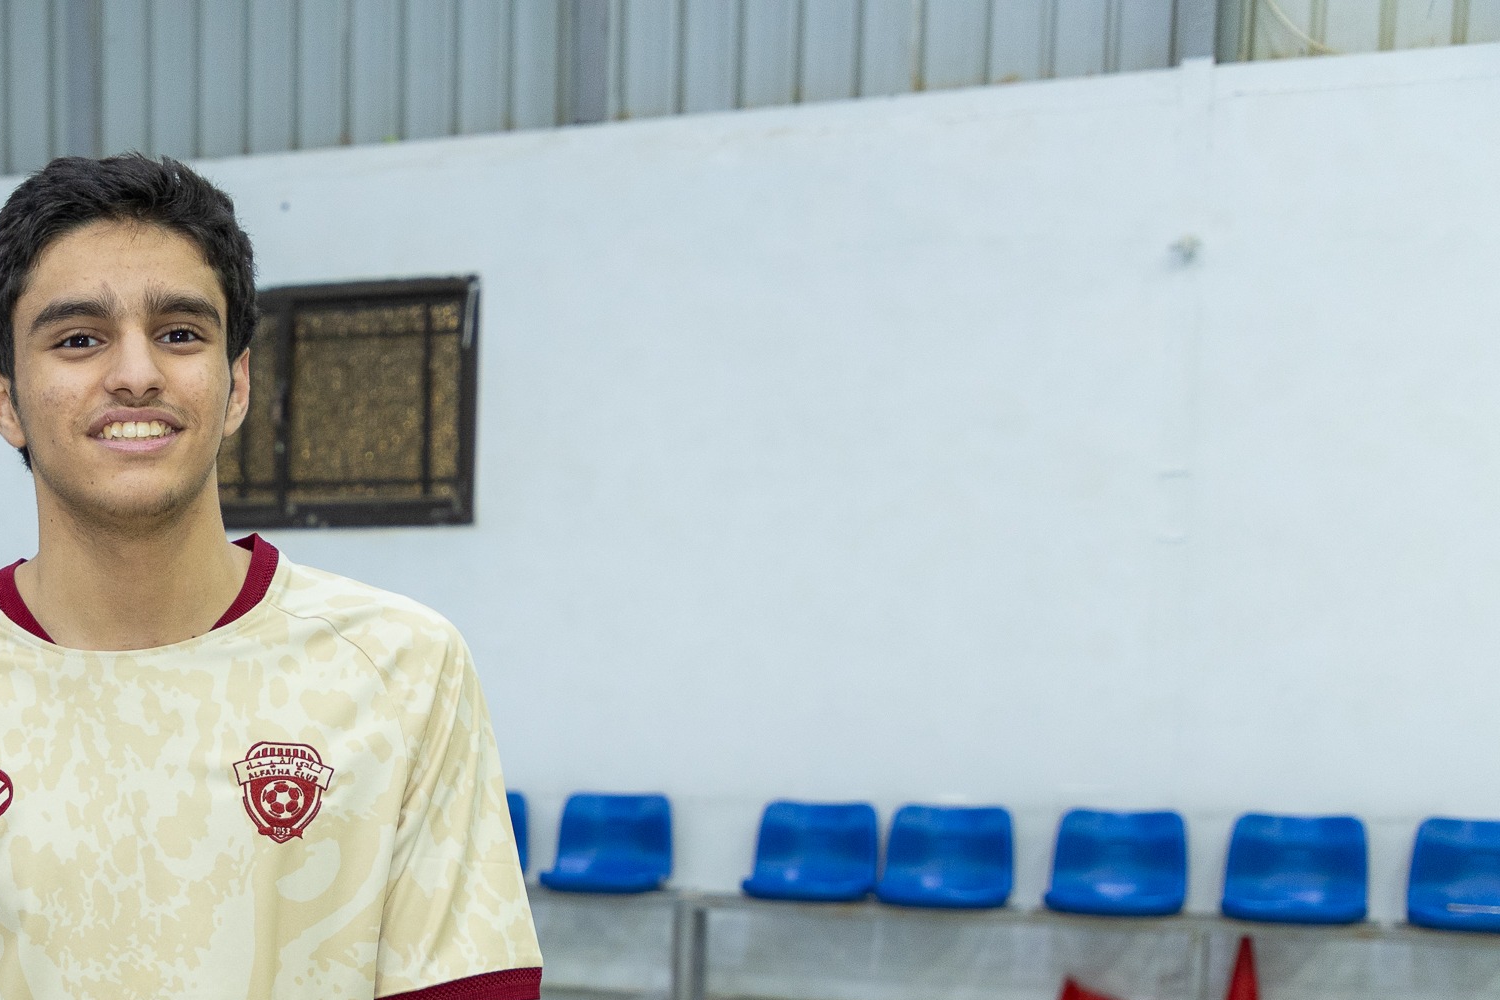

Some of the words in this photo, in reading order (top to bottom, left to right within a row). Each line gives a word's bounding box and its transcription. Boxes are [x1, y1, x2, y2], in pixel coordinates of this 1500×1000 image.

[246, 757, 295, 770] الفيحاء
[296, 761, 324, 774] نادي
[248, 769, 291, 780] ALFAYHA
[294, 770, 319, 783] CLUB
[273, 826, 291, 835] 1953
